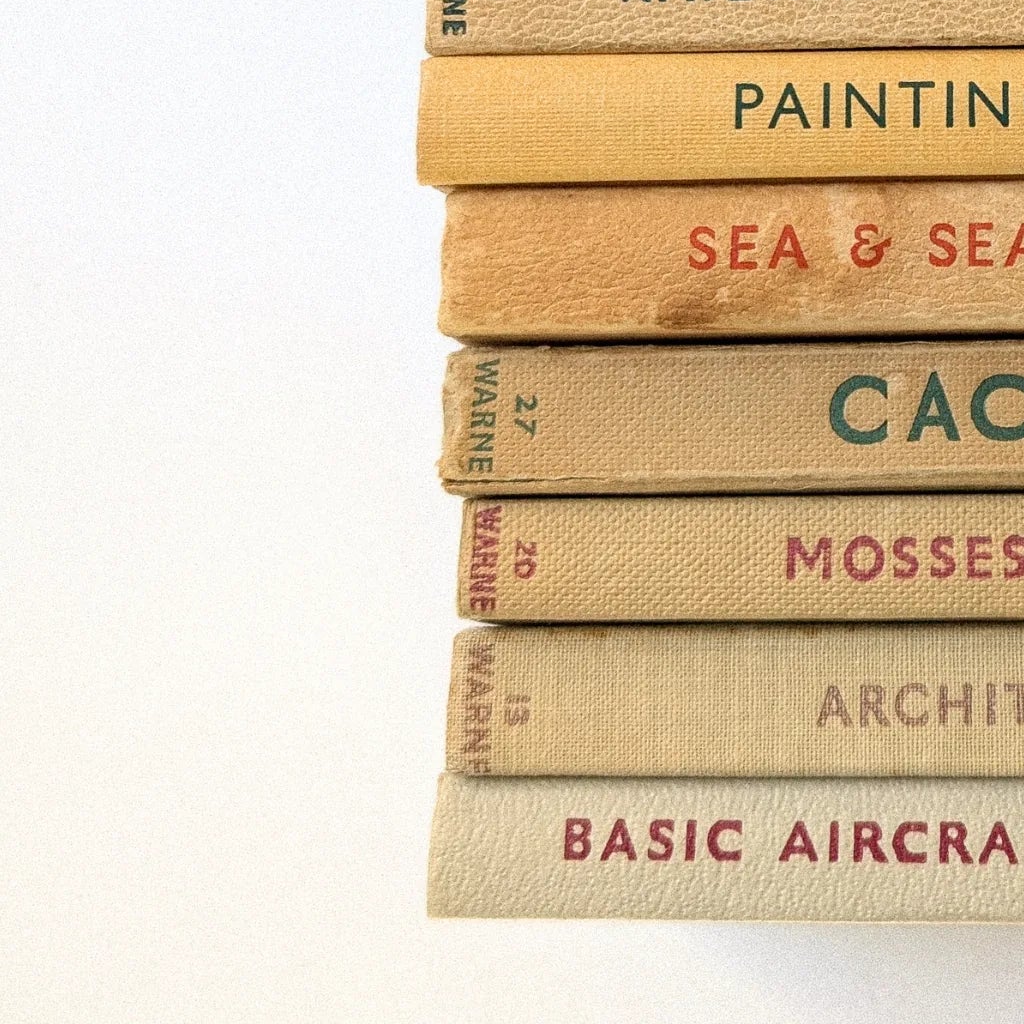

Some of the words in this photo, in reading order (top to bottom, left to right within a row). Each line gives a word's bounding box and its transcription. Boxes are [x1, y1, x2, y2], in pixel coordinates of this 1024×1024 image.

[688, 222, 809, 270] SEA
[850, 222, 892, 268] &
[466, 358, 500, 475] WARNE
[514, 395, 538, 438] 27
[470, 504, 501, 614] WARNE
[515, 540, 538, 580] 20
[563, 818, 744, 863] BASIC
